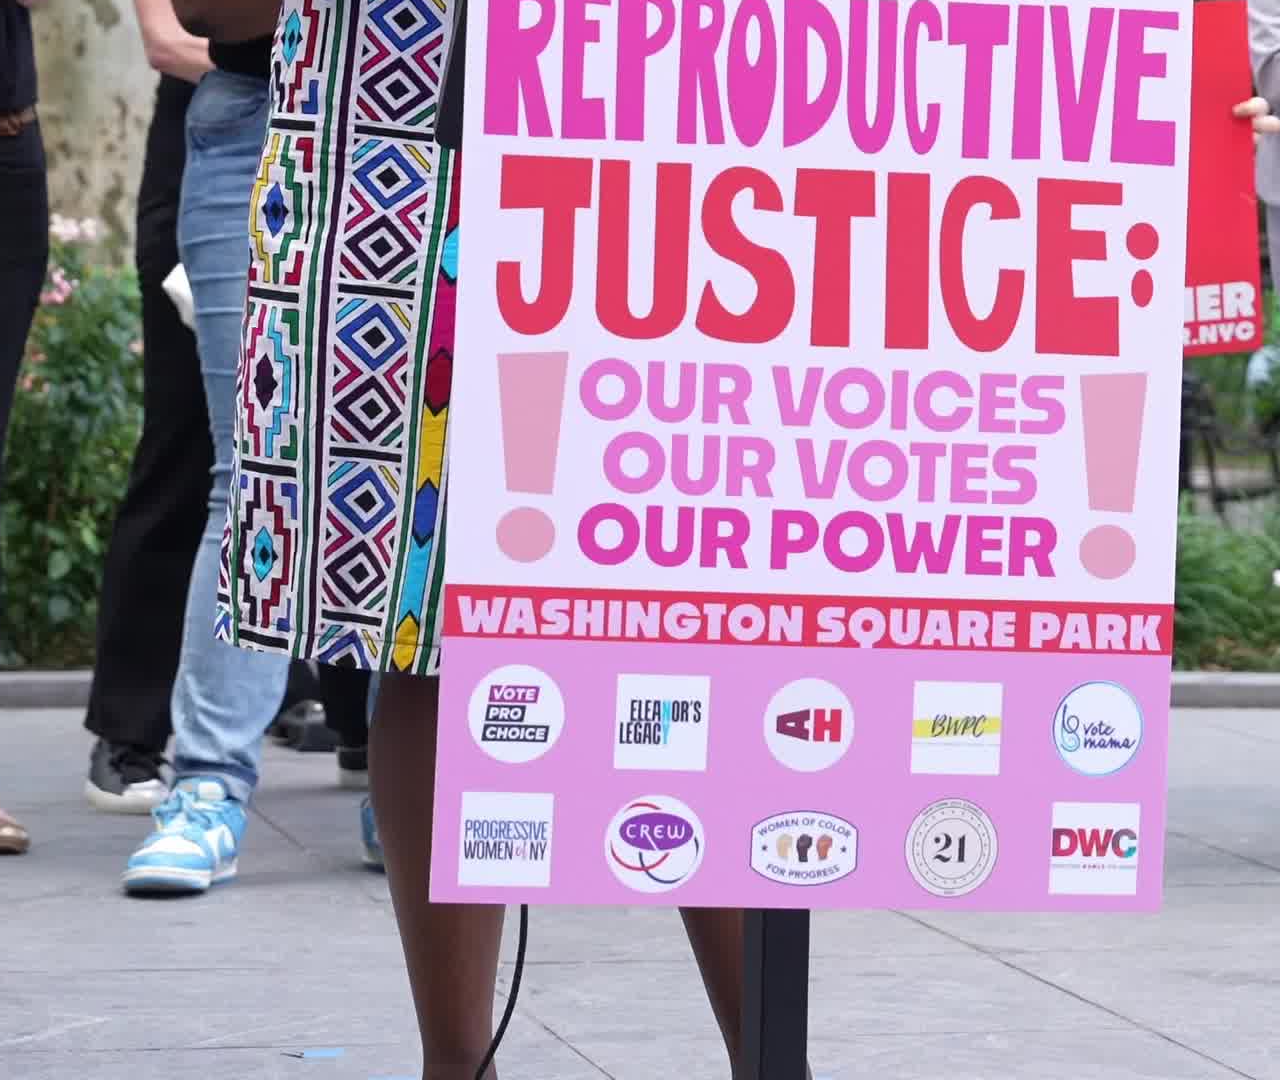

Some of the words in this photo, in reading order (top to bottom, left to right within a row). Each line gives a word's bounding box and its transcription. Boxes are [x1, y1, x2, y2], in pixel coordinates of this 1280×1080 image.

[495, 153, 1160, 357] JUSTICE:
[578, 357, 753, 423] OUR
[772, 365, 1066, 435] VOICES
[602, 430, 776, 498] OUR
[795, 438, 1038, 505] VOTES
[577, 502, 748, 570] OUR
[769, 508, 1058, 578] POWER
[457, 594, 804, 644] WASHINGTON
[817, 605, 1017, 649] SQUARE
[1028, 610, 1163, 652] PARK
[493, 685, 538, 701] VOTE
[488, 706, 523, 721] PRO
[630, 699, 702, 723] ELEANOR'S
[485, 726, 547, 741] CHOICE
[619, 721, 670, 745] LEGACY
[464, 819, 549, 841] PROGRESSIVE
[625, 824, 686, 851] CREW
[758, 817, 799, 837] WOMEN
[802, 817, 816, 827] OF
[818, 820, 852, 839] COLOR
[464, 839, 513, 861] WOMEN
[529, 840, 548, 861] NY
[932, 832, 967, 863] 21
[1052, 827, 1137, 859] DWC
[766, 863, 786, 877] FOR
[788, 864, 841, 880] PROGRESS
